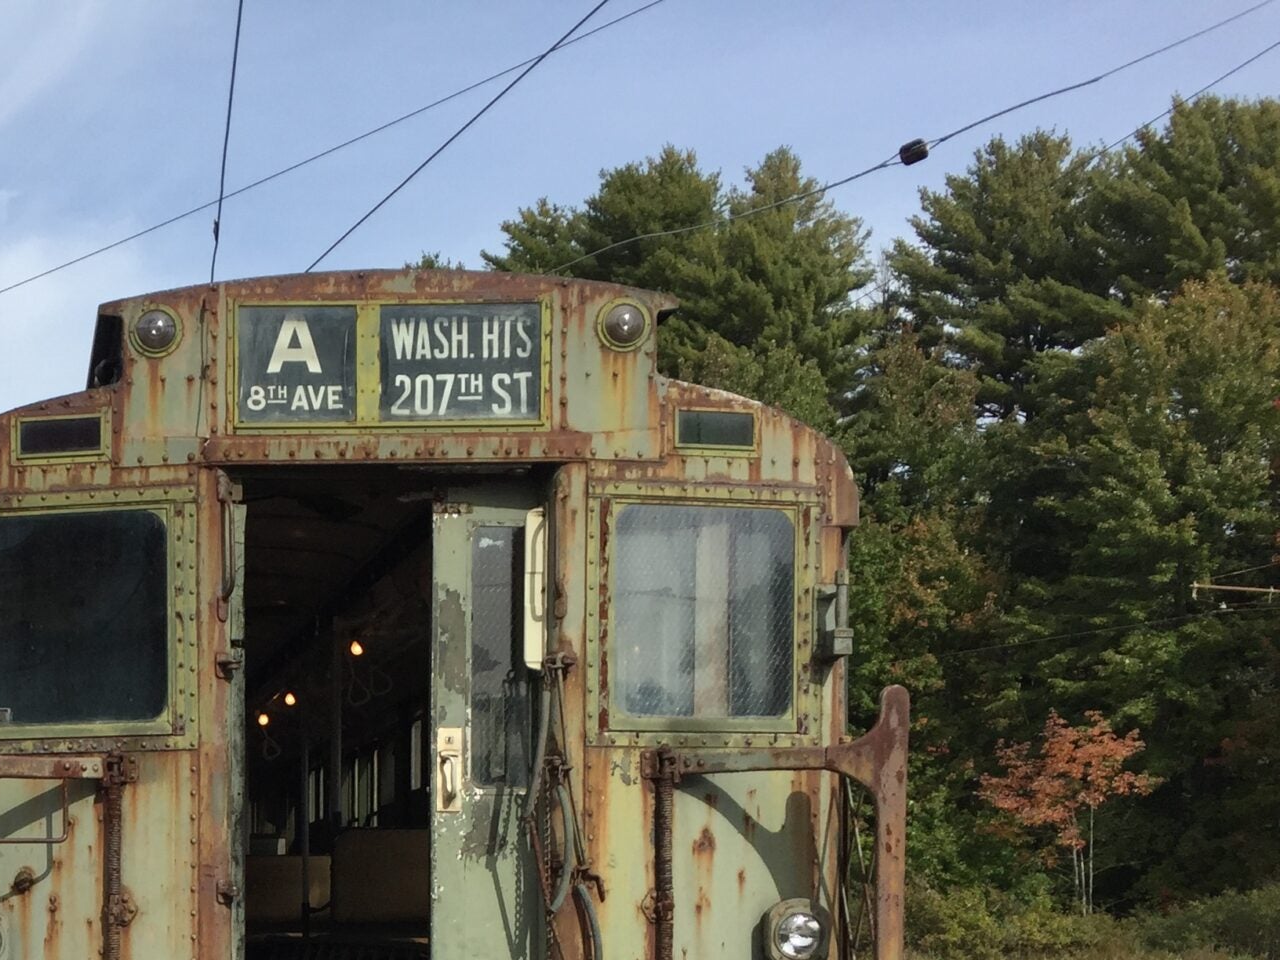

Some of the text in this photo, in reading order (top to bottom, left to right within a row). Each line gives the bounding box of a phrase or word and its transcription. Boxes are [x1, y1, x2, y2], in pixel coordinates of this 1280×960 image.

[266, 313, 323, 374] A
[390, 316, 533, 360] WASH. HTS
[246, 385, 344, 411] 8TH AVE
[390, 371, 533, 417] 207TH ST
